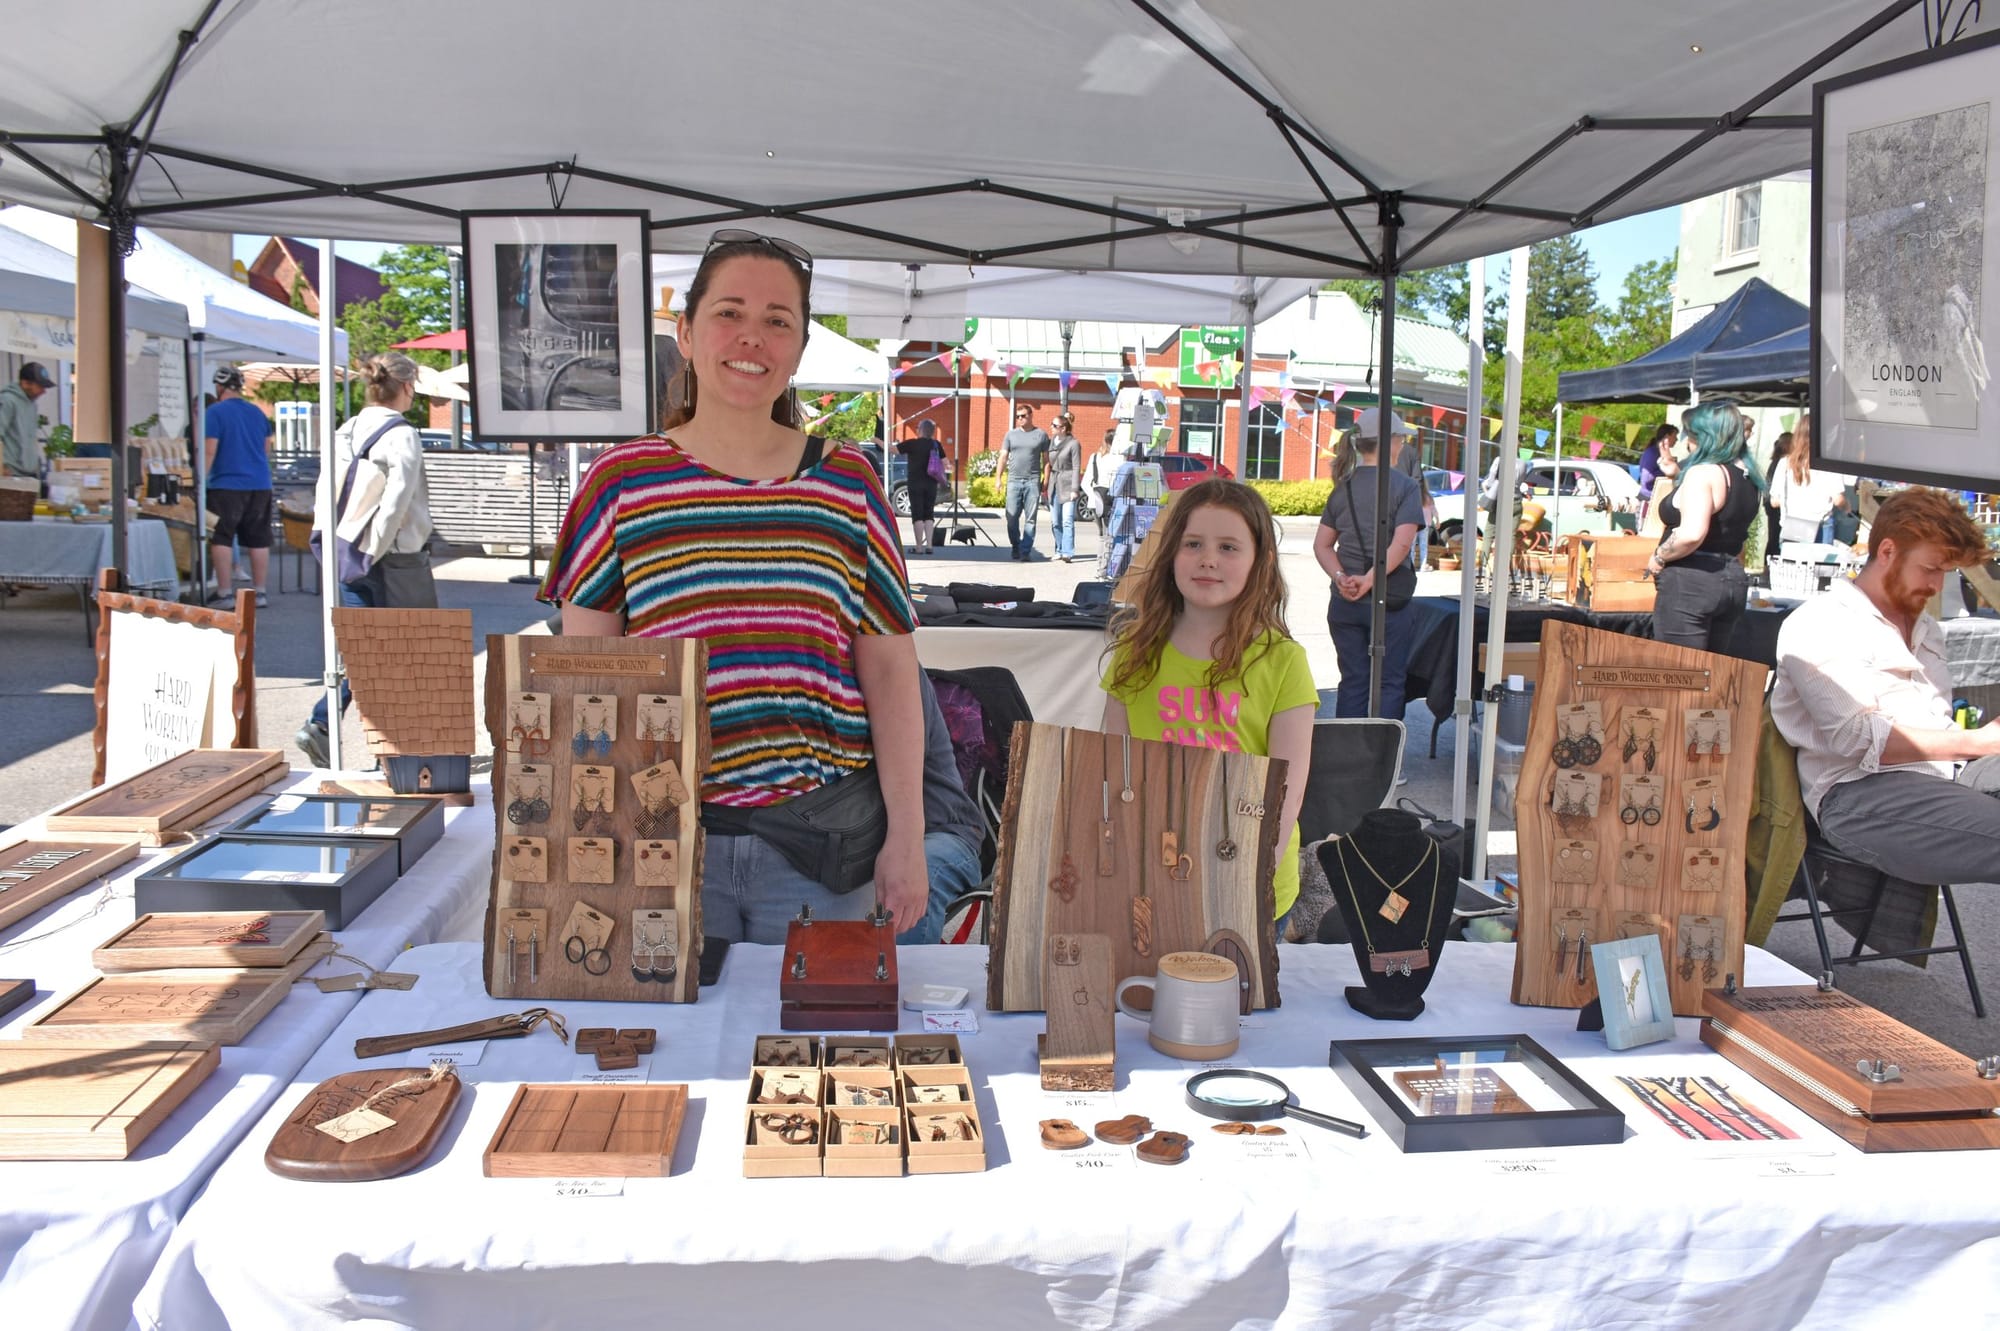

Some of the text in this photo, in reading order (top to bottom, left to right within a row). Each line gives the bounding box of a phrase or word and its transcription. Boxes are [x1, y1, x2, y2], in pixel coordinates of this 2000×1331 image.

[1872, 364, 1942, 383] LONDON
[1889, 388, 1922, 397] ENGLAND
[546, 658, 571, 669] HARD
[575, 658, 614, 670] WORKING
[1592, 670, 1694, 686] HARD WORKING BUNNY
[154, 671, 192, 708] HARD
[1158, 685, 1241, 727] SUN
